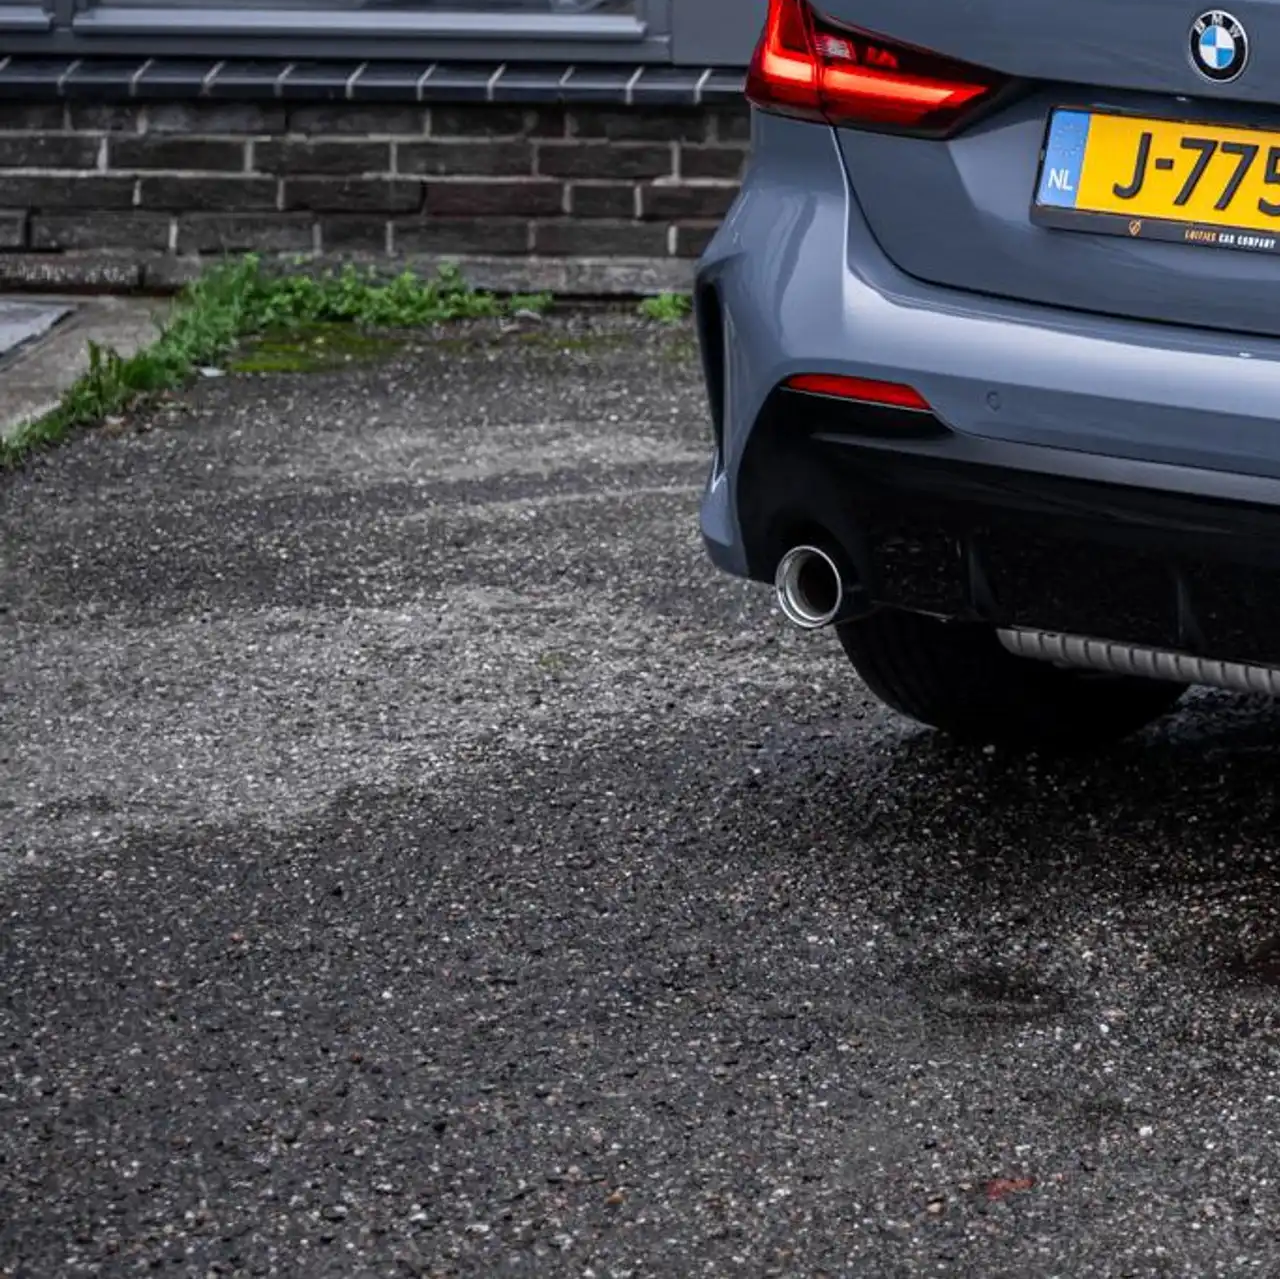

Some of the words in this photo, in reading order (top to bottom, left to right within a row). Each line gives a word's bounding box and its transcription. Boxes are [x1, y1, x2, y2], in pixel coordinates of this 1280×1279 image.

[1047, 167, 1073, 191] NL
[1218, 232, 1235, 244] CAR
[1237, 234, 1277, 249] COMPANY
